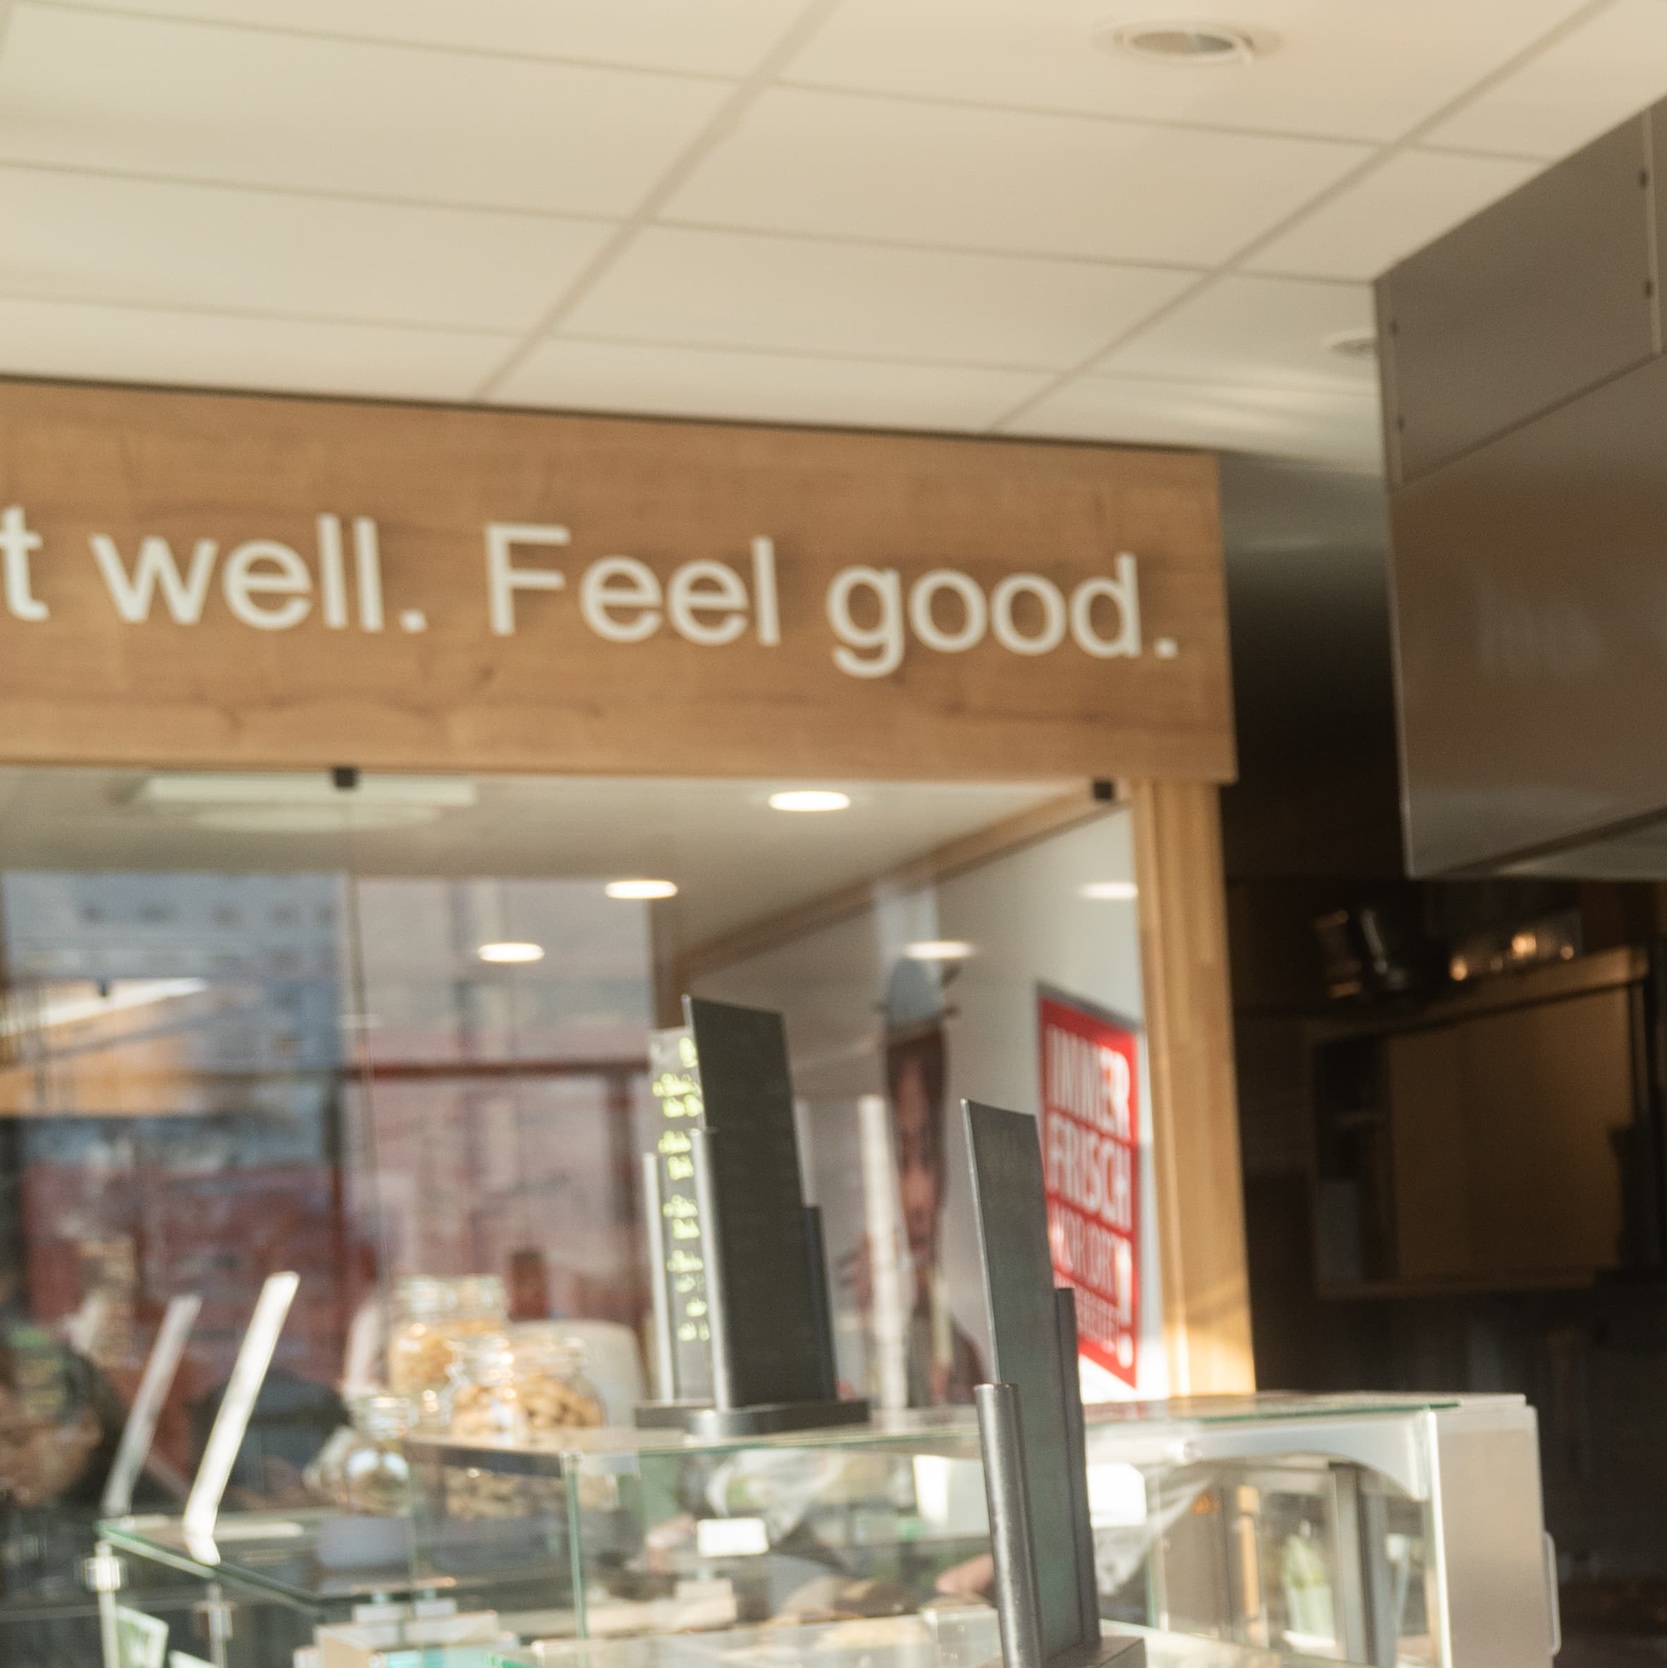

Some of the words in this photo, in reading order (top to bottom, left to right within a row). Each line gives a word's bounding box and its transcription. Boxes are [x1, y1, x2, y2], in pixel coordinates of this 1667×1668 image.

[90, 514, 428, 635] well.
[484, 522, 783, 648] Feel
[827, 552, 1181, 682] good.
[1046, 1108, 1131, 1235] FRISCH
